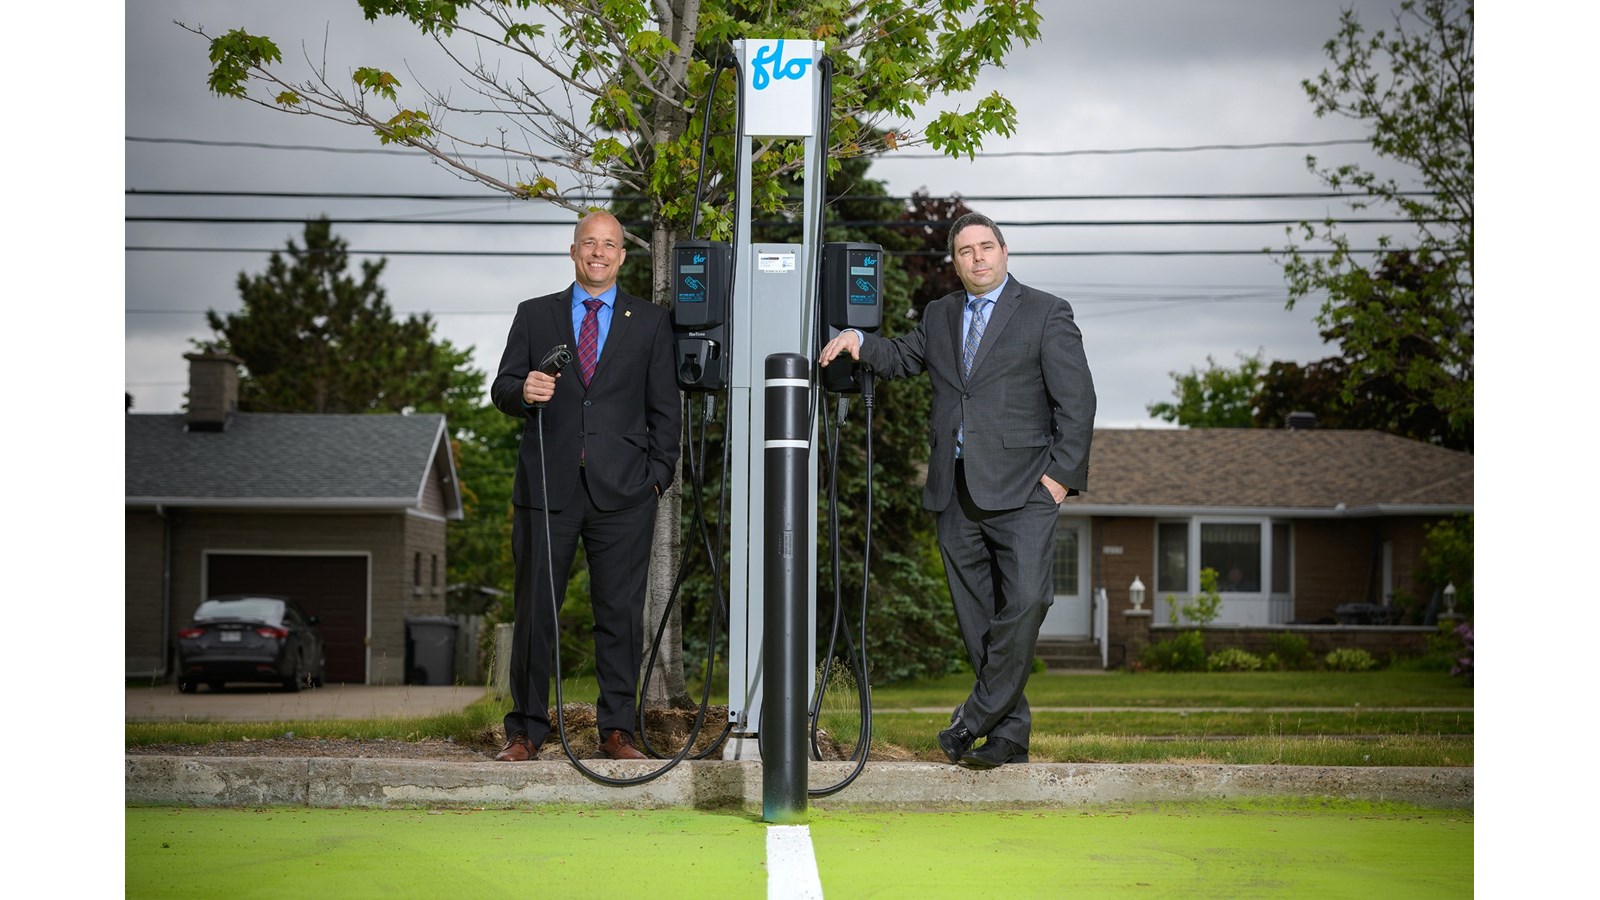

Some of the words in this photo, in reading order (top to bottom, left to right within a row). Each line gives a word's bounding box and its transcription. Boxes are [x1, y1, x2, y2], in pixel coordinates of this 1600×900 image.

[751, 39, 812, 90] flo
[693, 254, 706, 264] flo
[864, 257, 877, 266] flo
